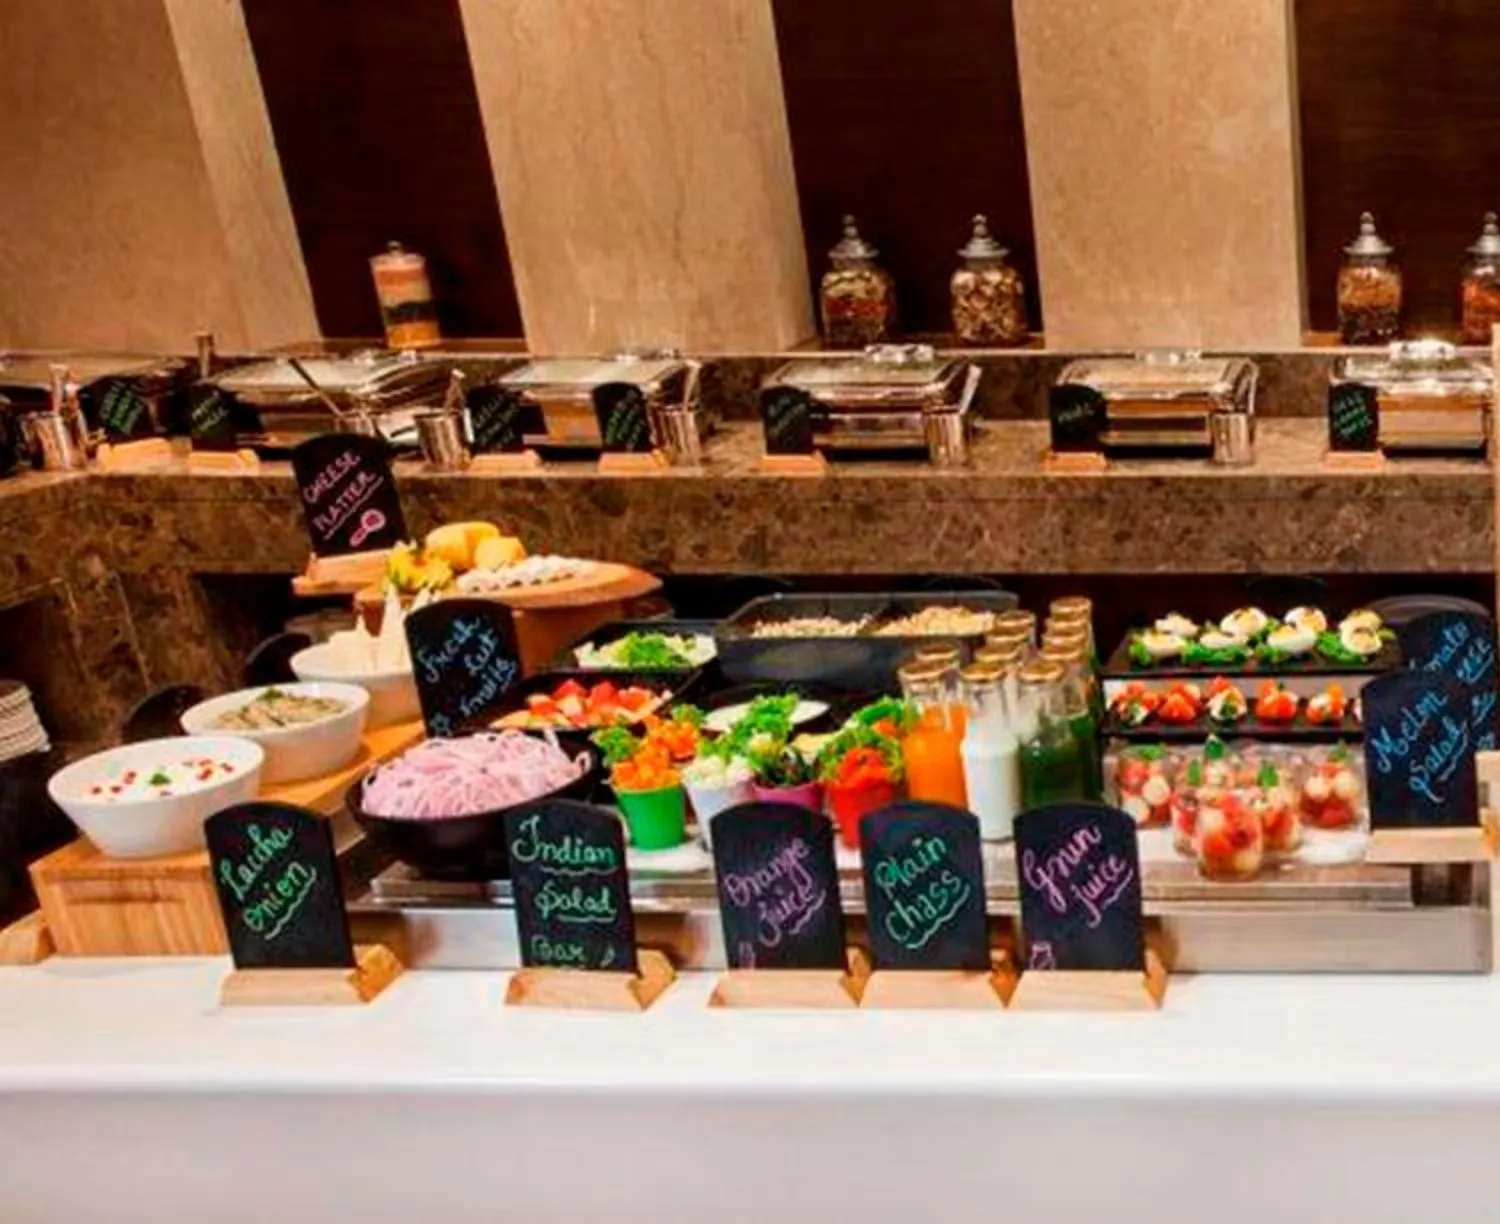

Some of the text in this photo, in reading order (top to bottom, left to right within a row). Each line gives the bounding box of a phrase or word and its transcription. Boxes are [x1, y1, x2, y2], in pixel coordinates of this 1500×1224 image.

[511, 815, 618, 863] Indian
[873, 836, 947, 900] Plain
[723, 837, 813, 907] Orange
